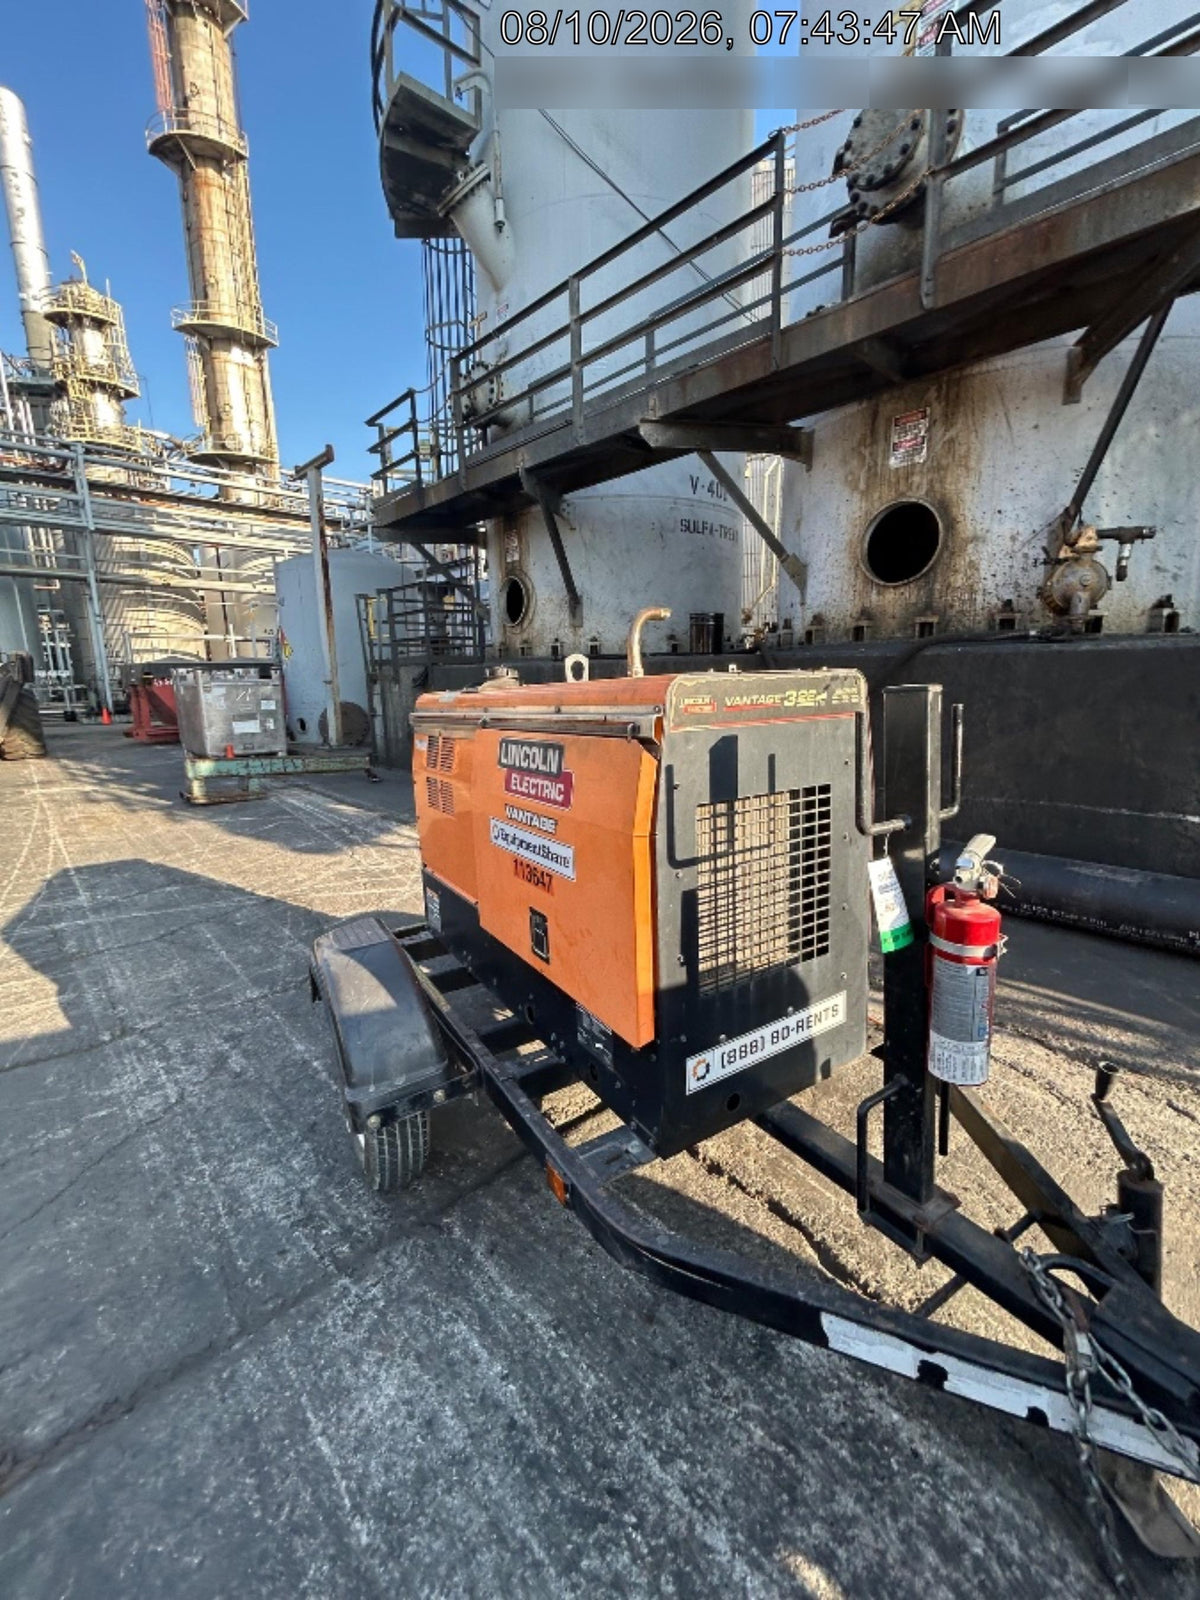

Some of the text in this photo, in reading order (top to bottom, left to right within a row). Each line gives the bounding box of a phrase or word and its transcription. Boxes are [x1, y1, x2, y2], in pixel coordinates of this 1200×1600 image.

[725, 694, 782, 706] VANTAGE
[500, 742, 560, 775] LINCOLN
[511, 773, 565, 803] ELECTRIC
[505, 804, 558, 834] VANTAGE
[721, 1036, 766, 1069] (888)
